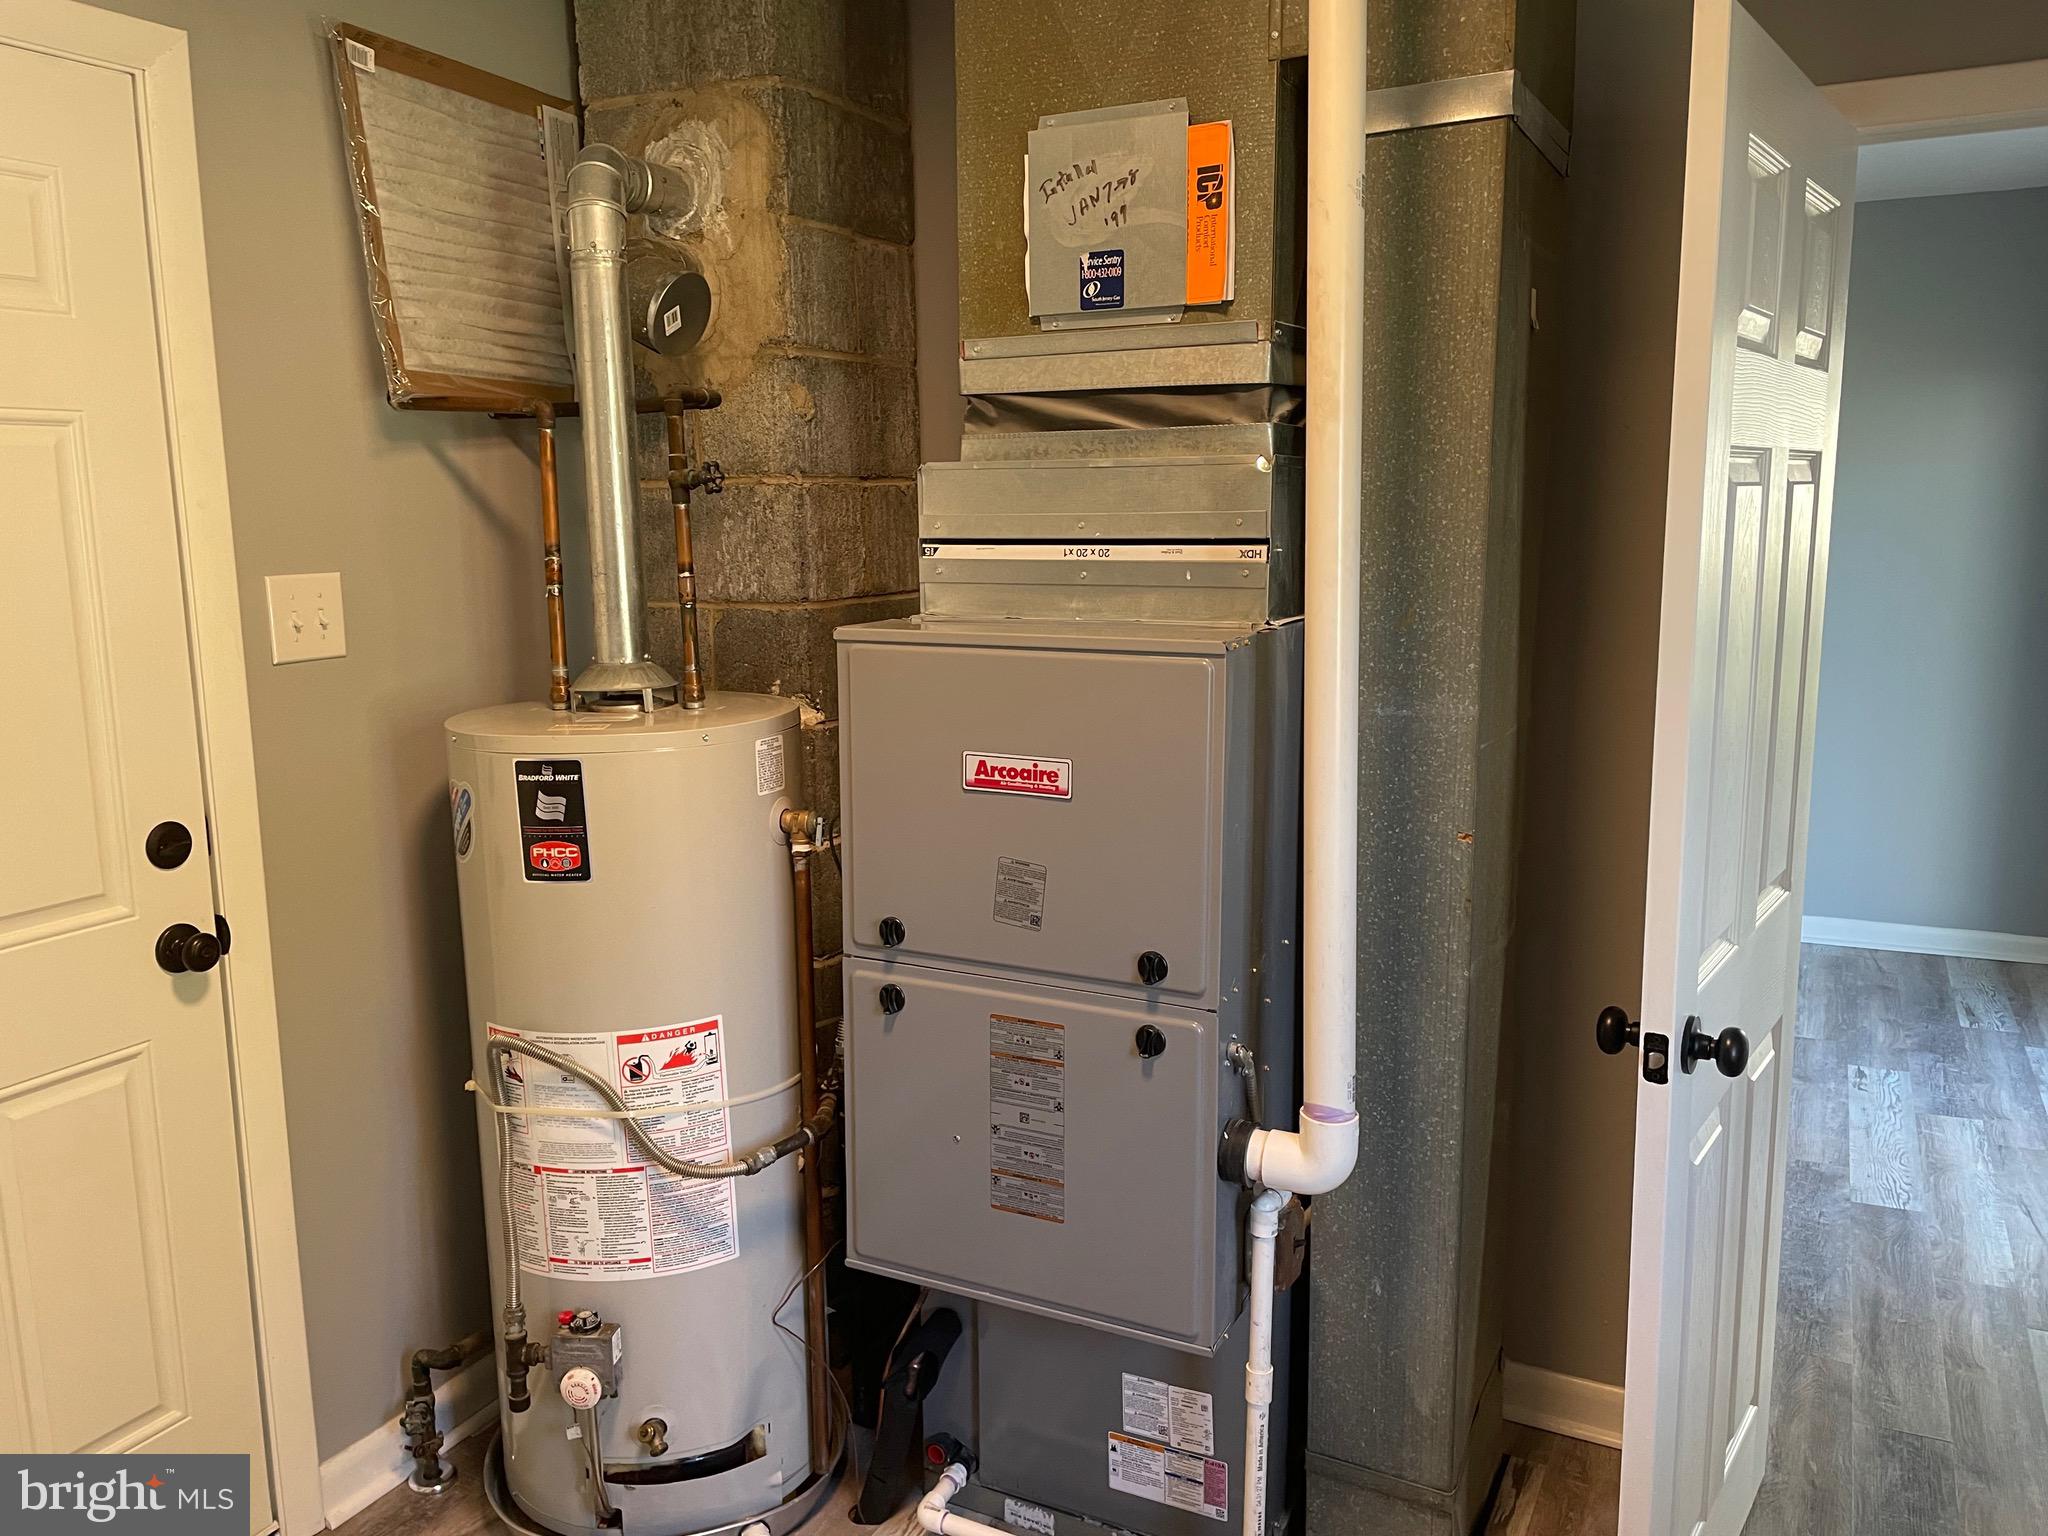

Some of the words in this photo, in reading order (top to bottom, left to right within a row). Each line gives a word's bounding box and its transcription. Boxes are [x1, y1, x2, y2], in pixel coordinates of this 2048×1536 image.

[1196, 163, 1224, 210] ICP
[1103, 254, 1122, 267] Sentry
[1076, 548, 1088, 557] 20
[1098, 548, 1110, 558] 20
[1239, 549, 1262, 559] HDX
[975, 760, 1059, 784] Arcoaire
[518, 774, 554, 782] BRADFORD
[532, 847, 578, 858] PHCC
[651, 1026, 696, 1040] DANGER
